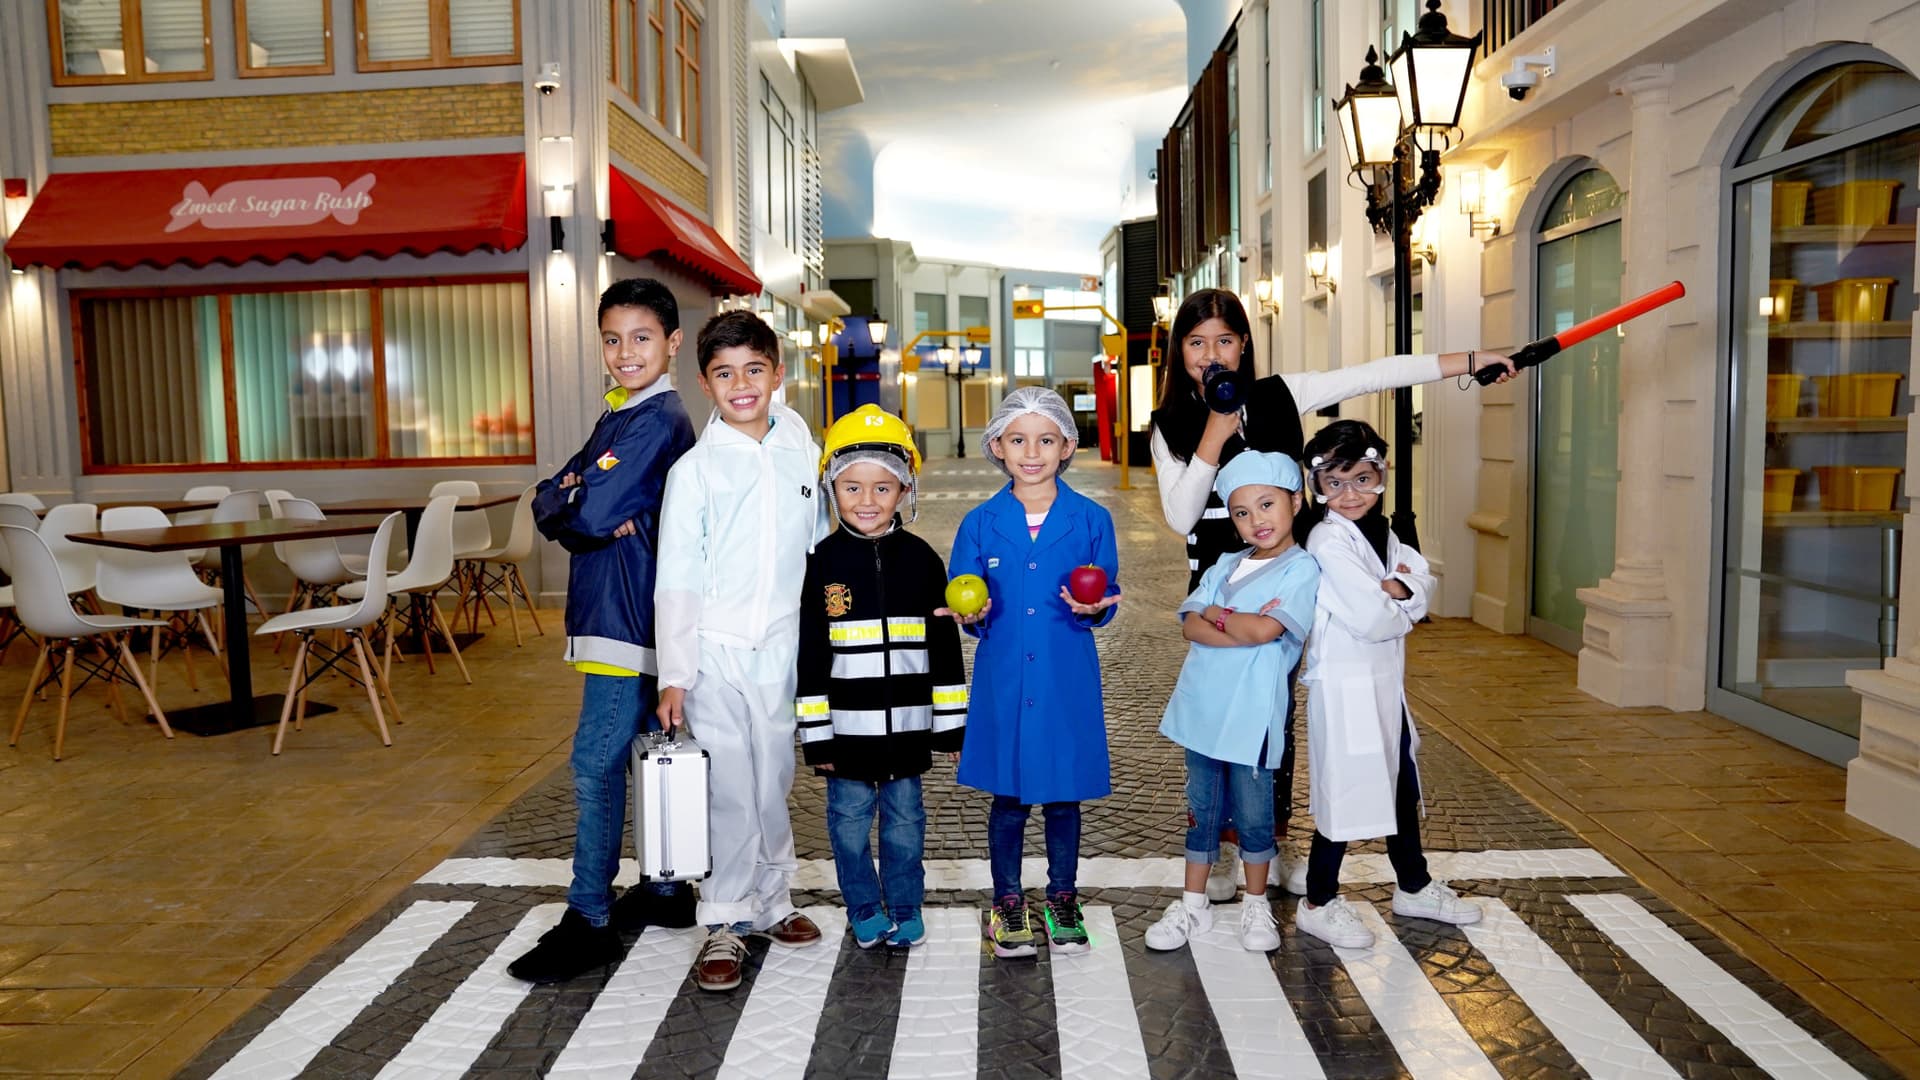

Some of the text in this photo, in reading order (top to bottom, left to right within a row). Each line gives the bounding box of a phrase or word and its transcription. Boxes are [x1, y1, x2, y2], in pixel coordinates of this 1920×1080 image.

[176, 191, 372, 218] Zweet Sugar Rush
